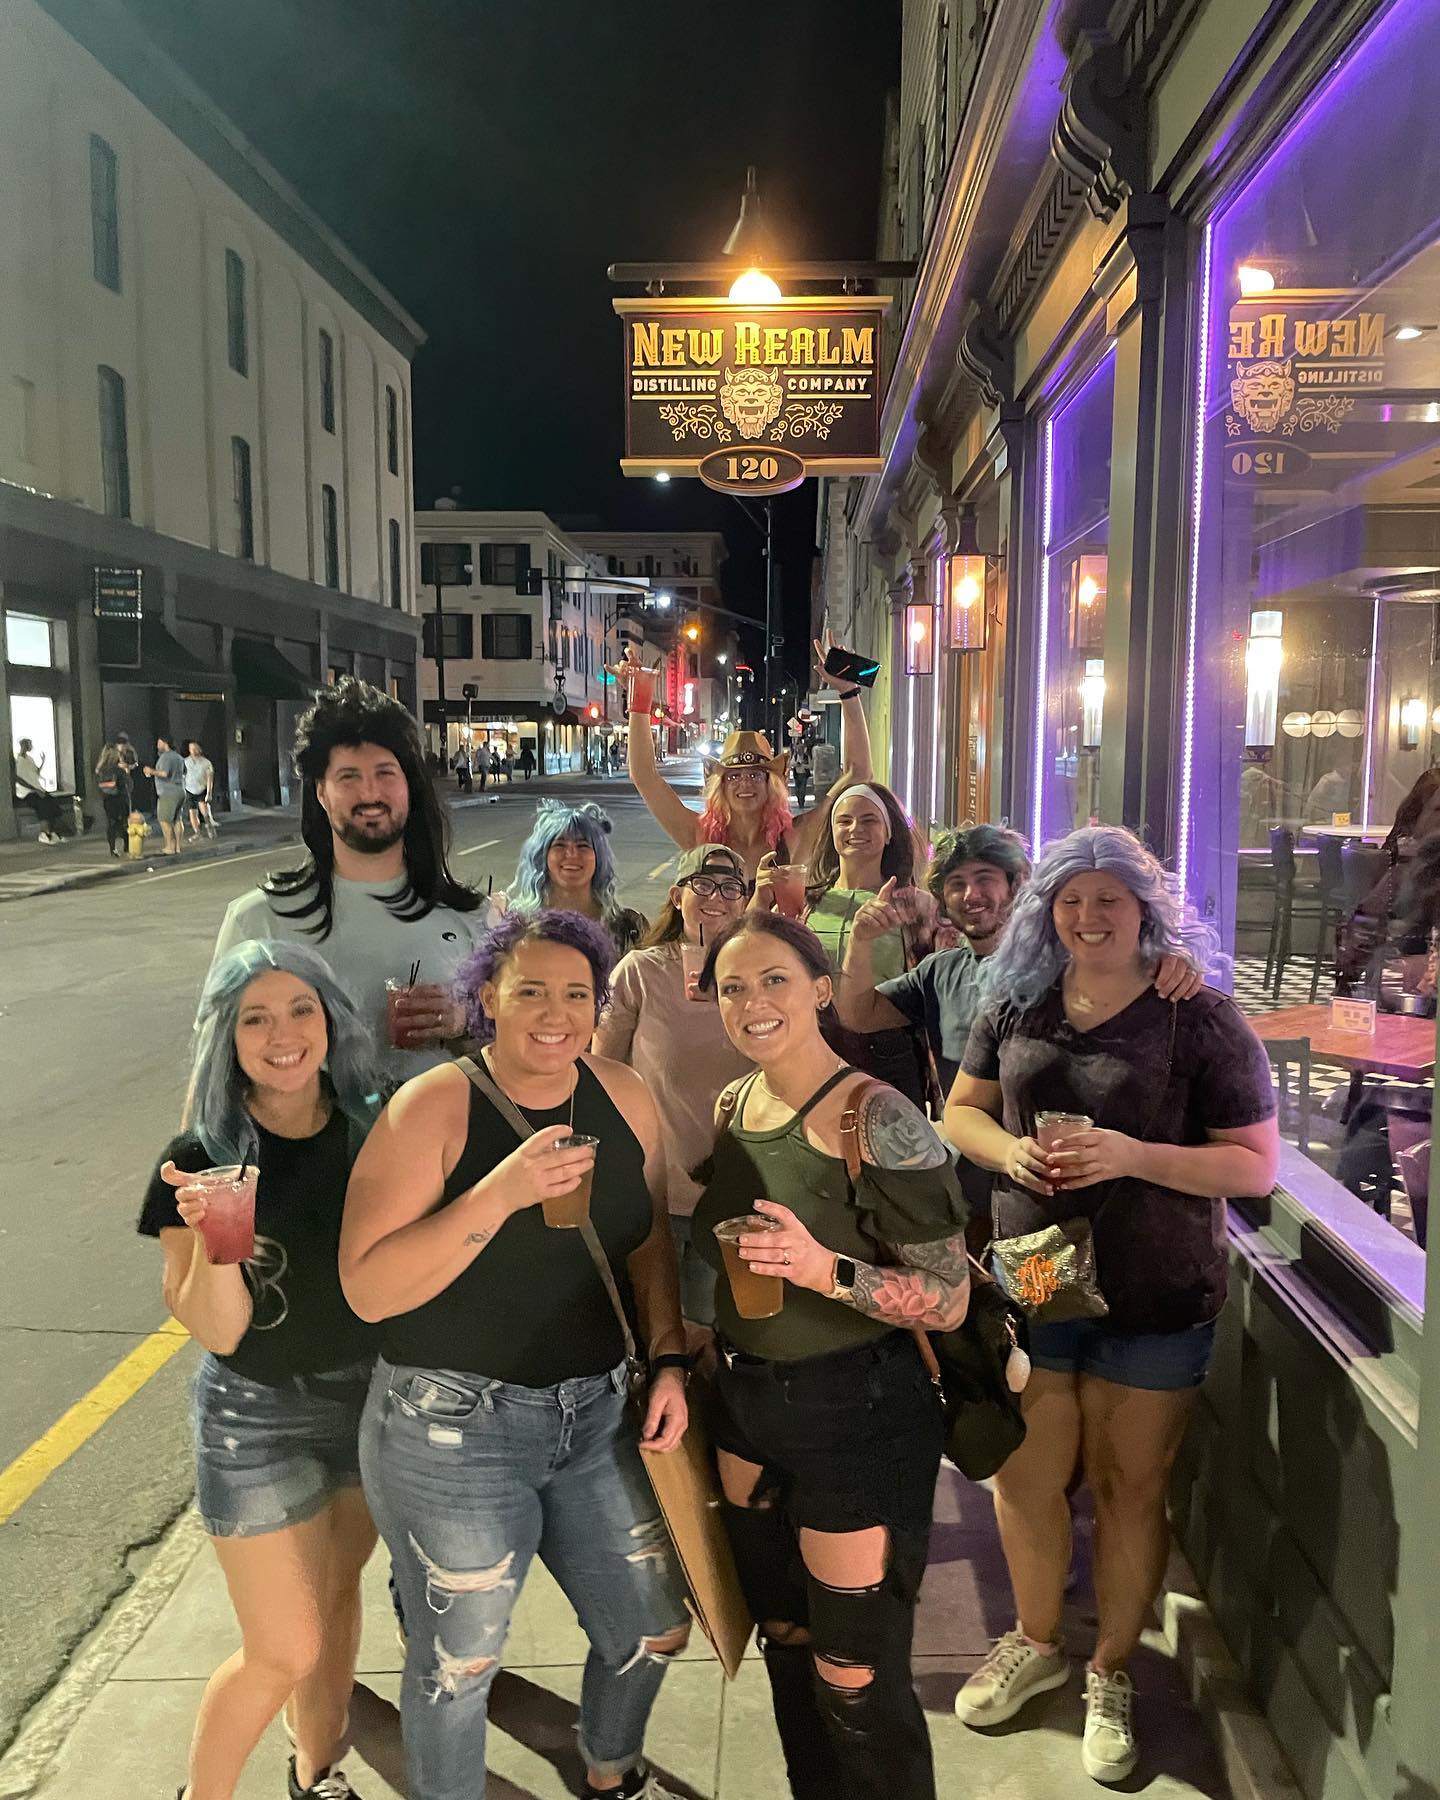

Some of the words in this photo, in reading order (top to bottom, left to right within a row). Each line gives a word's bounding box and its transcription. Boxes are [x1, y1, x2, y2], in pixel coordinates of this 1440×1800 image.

[631, 322, 725, 367] NEW
[733, 321, 875, 366] REALM
[633, 378, 718, 392] DISTILLING
[787, 377, 868, 391] COMPANY
[726, 457, 780, 480] 120
